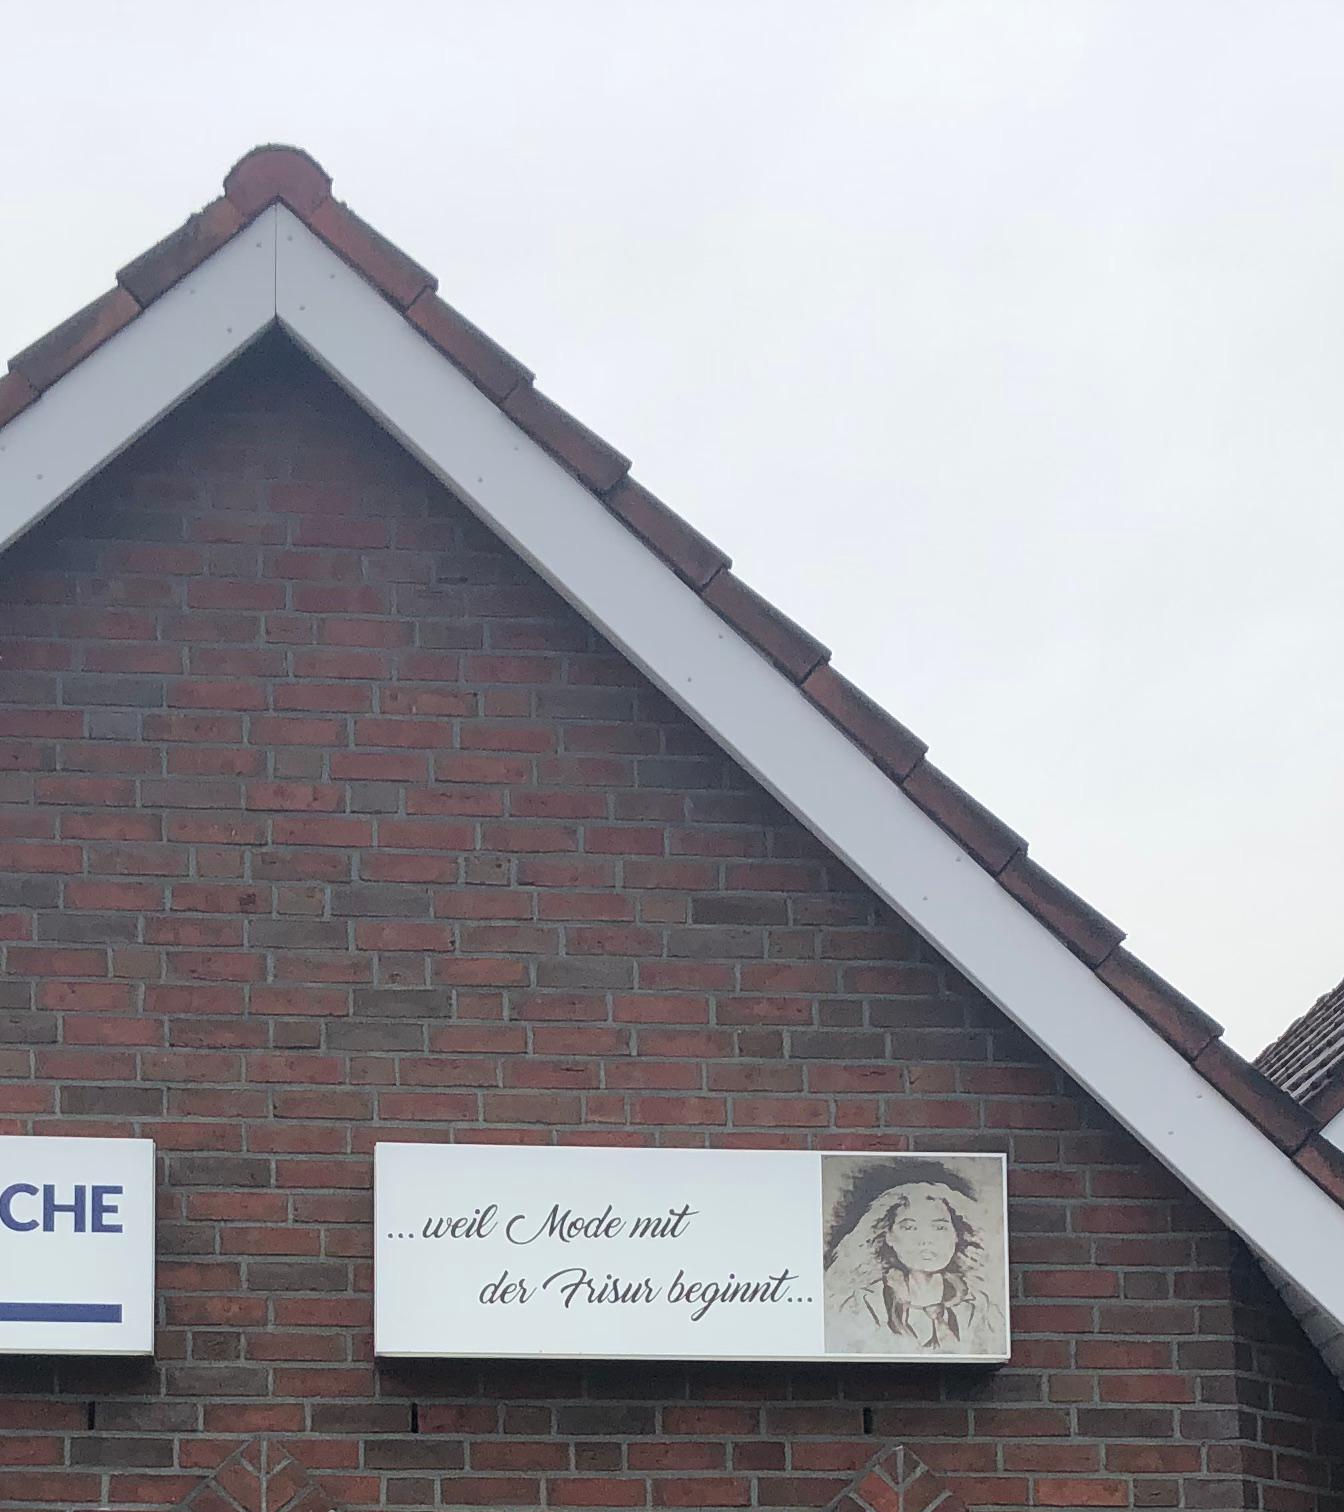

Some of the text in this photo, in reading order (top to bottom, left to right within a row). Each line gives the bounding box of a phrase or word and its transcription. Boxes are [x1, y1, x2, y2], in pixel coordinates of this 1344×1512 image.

[505, 1204, 627, 1245] Mode
[627, 1204, 700, 1239] mit
[478, 1270, 538, 1305] der
[542, 1267, 662, 1306] Frisur
